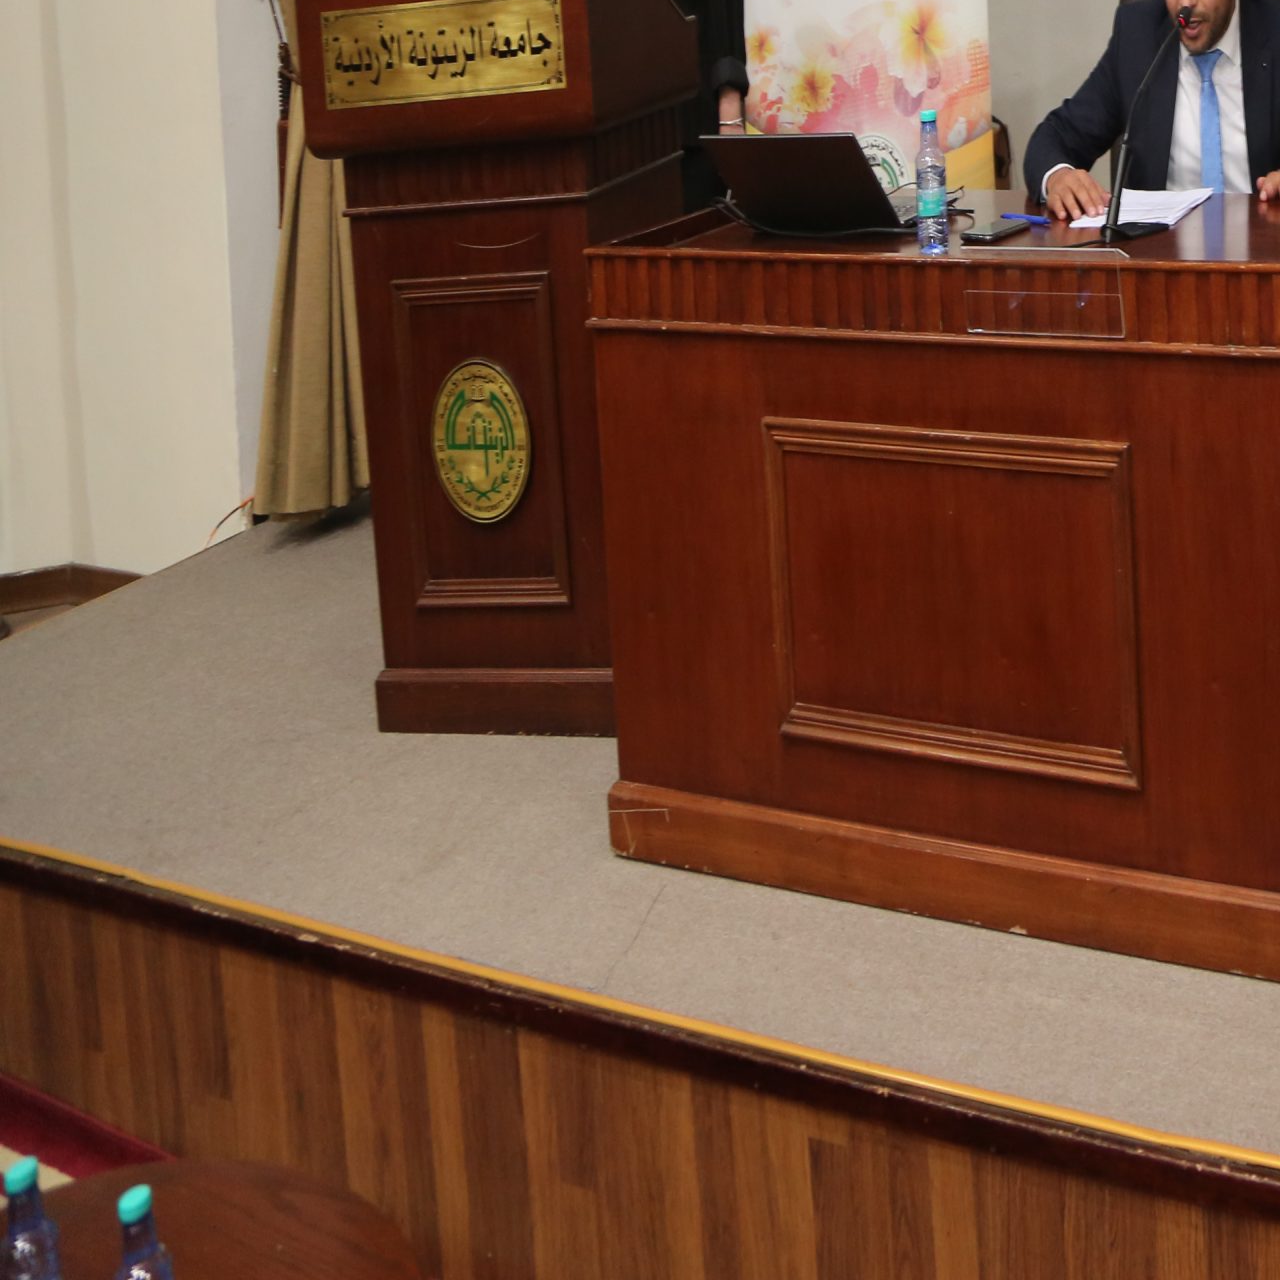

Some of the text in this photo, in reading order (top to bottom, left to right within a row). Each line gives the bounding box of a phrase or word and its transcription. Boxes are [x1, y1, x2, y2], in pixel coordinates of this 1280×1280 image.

[331, 18, 553, 86] جامعة الزيتونة الأردنية
